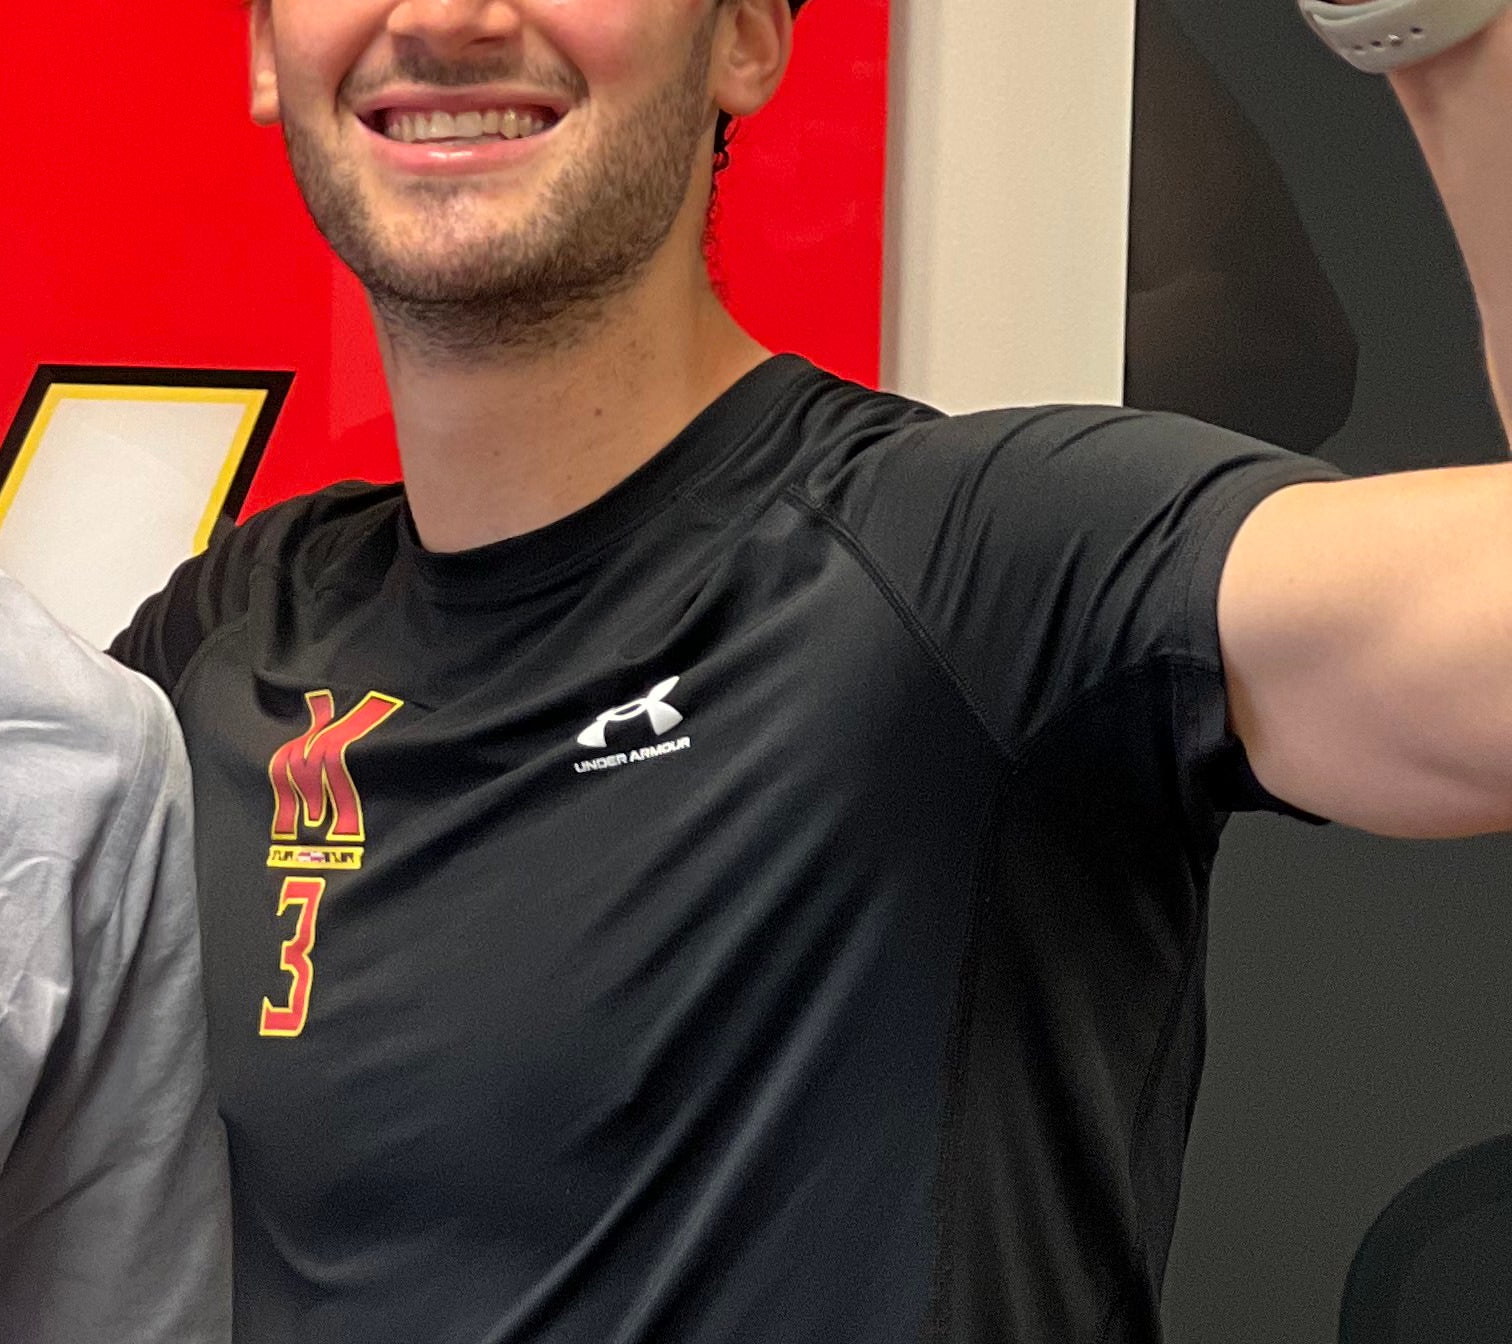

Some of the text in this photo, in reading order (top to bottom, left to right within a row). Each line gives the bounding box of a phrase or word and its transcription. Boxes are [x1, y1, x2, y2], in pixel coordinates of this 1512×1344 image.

[573, 735, 692, 774] UNDER ARMOUR
[258, 876, 327, 1037] 3
